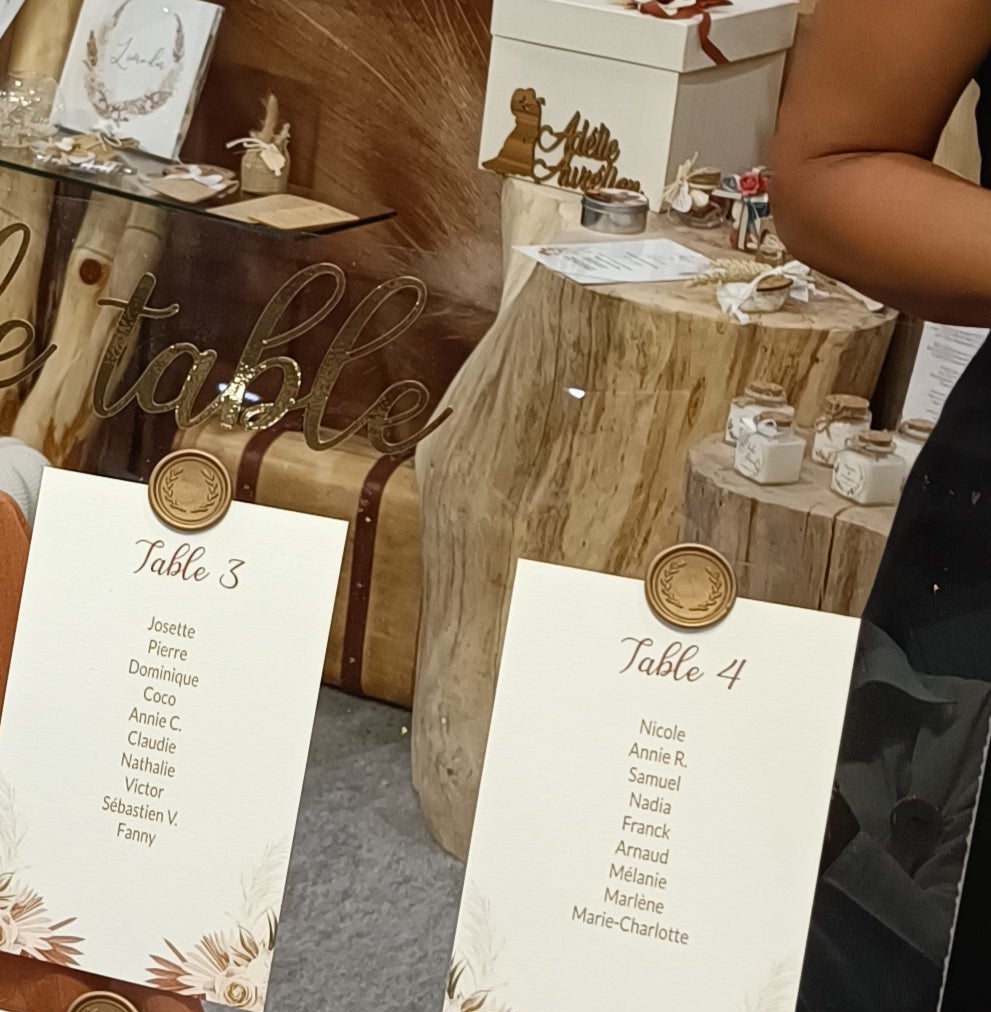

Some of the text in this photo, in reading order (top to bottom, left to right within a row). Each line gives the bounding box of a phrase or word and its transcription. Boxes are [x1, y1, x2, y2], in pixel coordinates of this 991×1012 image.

[93, 262, 451, 455] table
[133, 539, 245, 589] Table 3
[147, 616, 195, 639] Josette
[148, 640, 187, 661] Pierre
[128, 659, 199, 688] Dominique
[619, 637, 746, 690] Table 4
[143, 687, 176, 706] Coco
[128, 707, 182, 732] Annie C.
[640, 719, 685, 742] Nicole
[128, 731, 176, 754] Claudie
[628, 742, 687, 768] Annie R.
[121, 752, 175, 777] Nathalie
[125, 777, 164, 798] Victor
[628, 767, 680, 791] Samuel
[102, 796, 178, 826] Sébastien V.
[629, 792, 671, 815] Nadia
[117, 822, 156, 847] Fanny
[622, 815, 670, 840] Franck
[615, 840, 669, 864] Arnaud
[609, 864, 667, 889] Mélanie
[604, 887, 664, 914] Marlène
[572, 906, 689, 945] Marie-Charlotte
